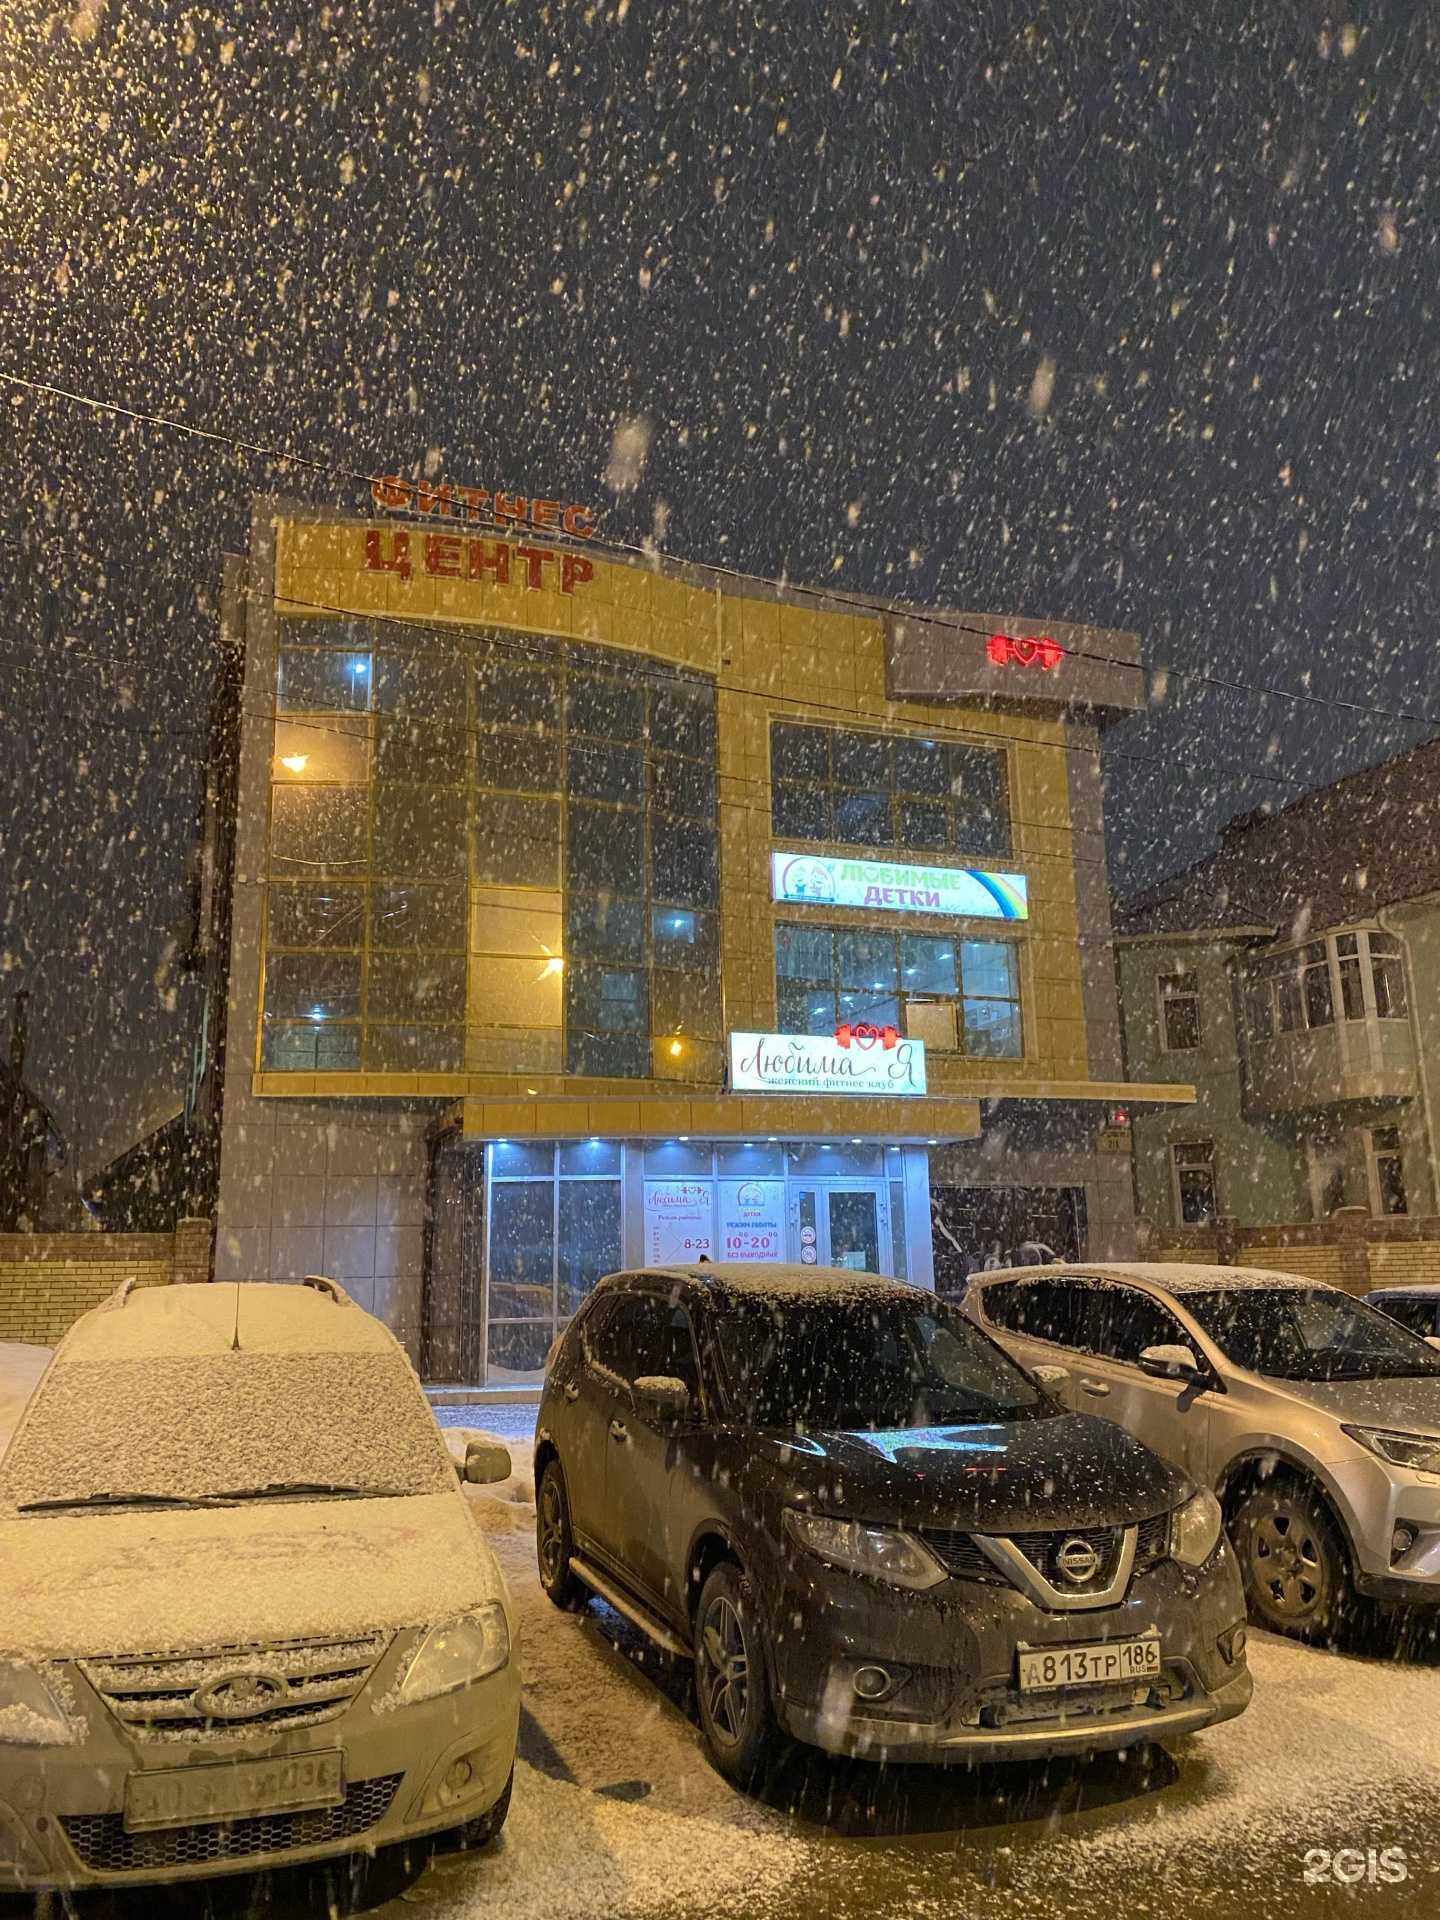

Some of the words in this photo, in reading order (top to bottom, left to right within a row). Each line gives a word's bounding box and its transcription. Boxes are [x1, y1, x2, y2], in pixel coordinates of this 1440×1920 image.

[371, 475, 594, 539] ФИТНЕС
[365, 530, 594, 596] ЦЕНТР
[840, 864, 960, 890] ЛЮБИМЫЕ
[863, 885, 941, 908] ДЕТКИ
[740, 1037, 877, 1078] Любима
[887, 1043, 917, 1088] Я
[823, 1078, 864, 1088] фитнес
[868, 1078, 895, 1089] клуб
[684, 1238, 710, 1249] 8-23
[1062, 1555, 1096, 1566] NISSAN
[1122, 1643, 1156, 1667] 186
[1129, 1664, 1147, 1674] RUS
